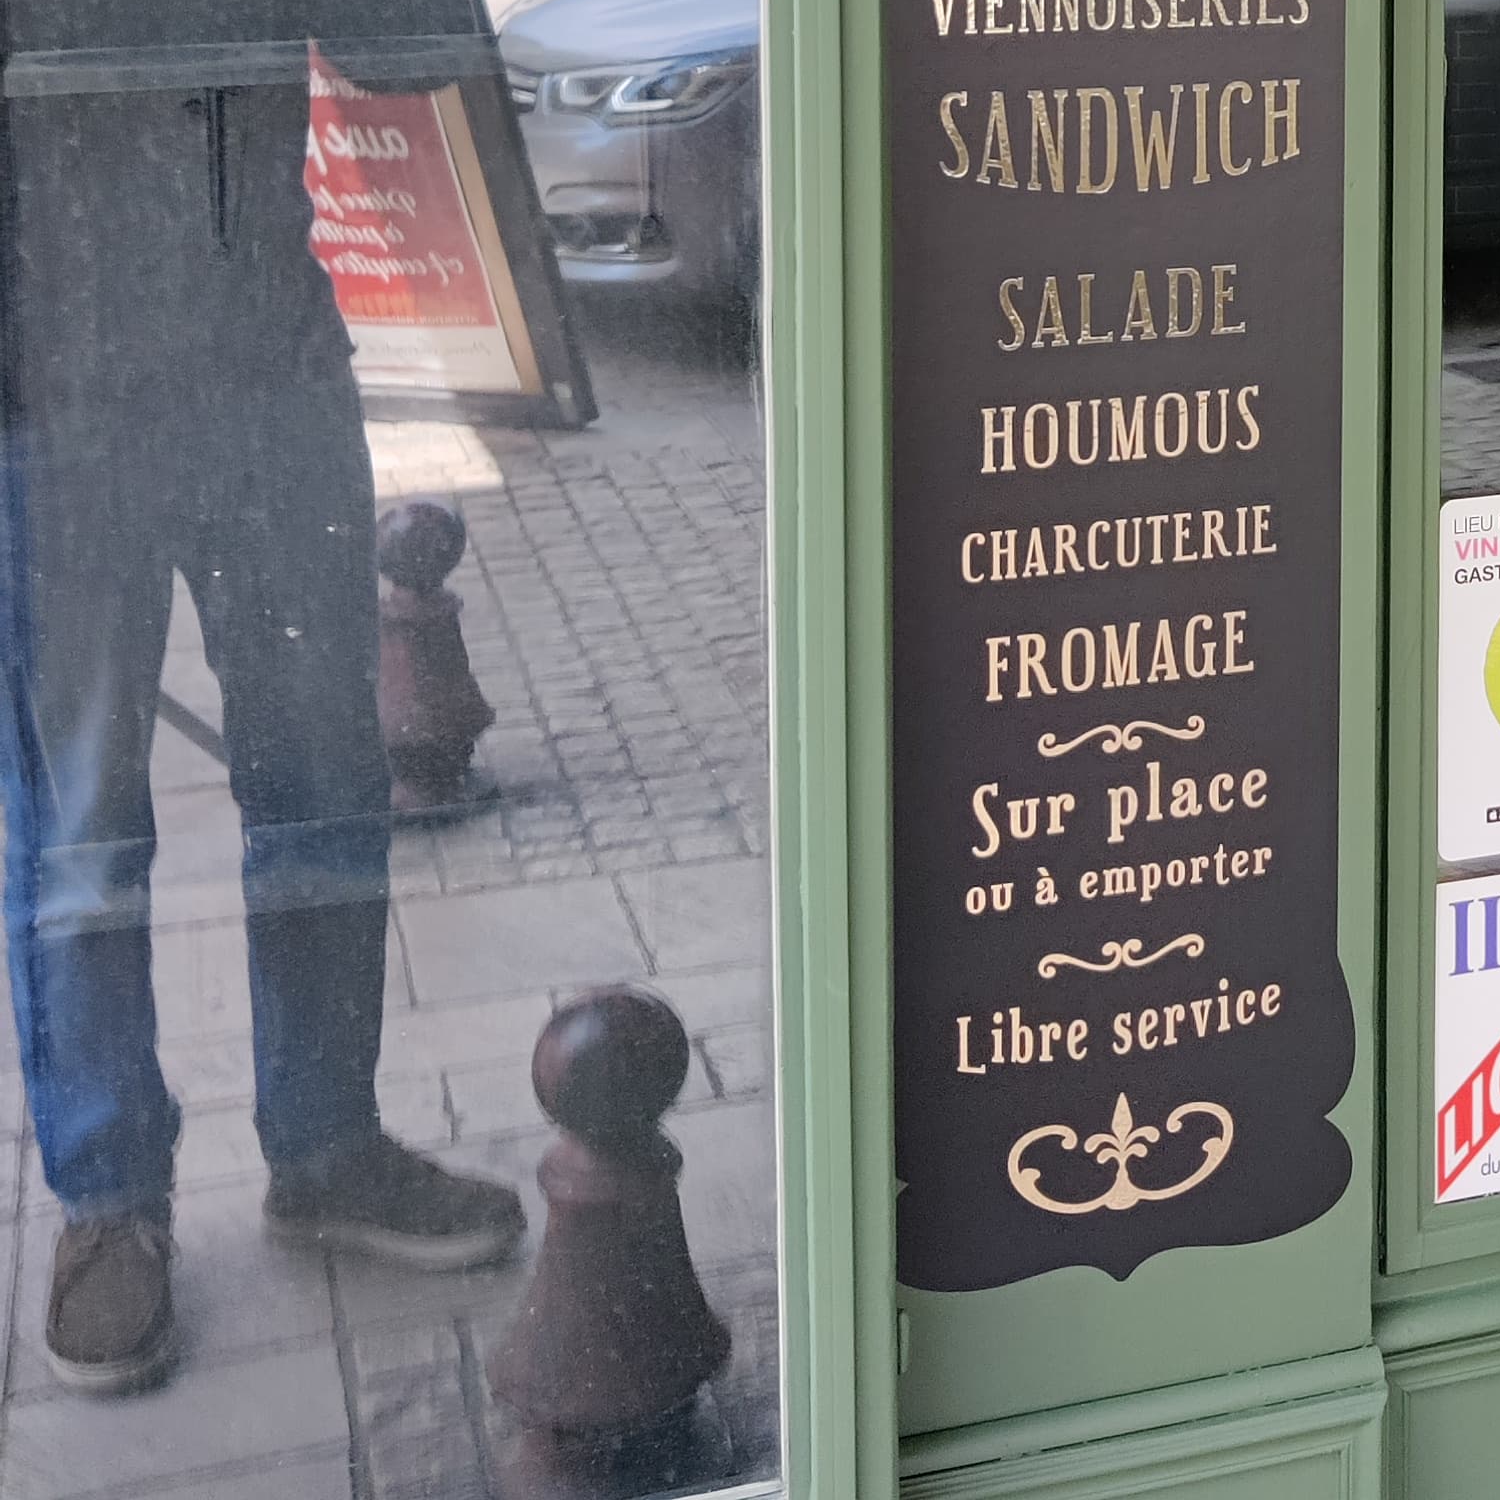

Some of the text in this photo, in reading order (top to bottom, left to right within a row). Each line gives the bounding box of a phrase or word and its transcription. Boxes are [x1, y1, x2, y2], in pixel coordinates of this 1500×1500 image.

[939, 78, 1301, 195] SANDWICH
[997, 263, 1246, 352] SALADE
[980, 384, 1260, 474] HOUMOUS
[961, 504, 1277, 584] CHARCUTERIE
[1454, 514, 1493, 534] LIEU
[1454, 536, 1499, 561] VIN
[985, 610, 1255, 702] FROMAGE
[971, 761, 1268, 858] Sur place
[965, 843, 1273, 915] ou à emporter
[956, 977, 1281, 1075] Libre service
[1480, 1153, 1500, 1177] du
